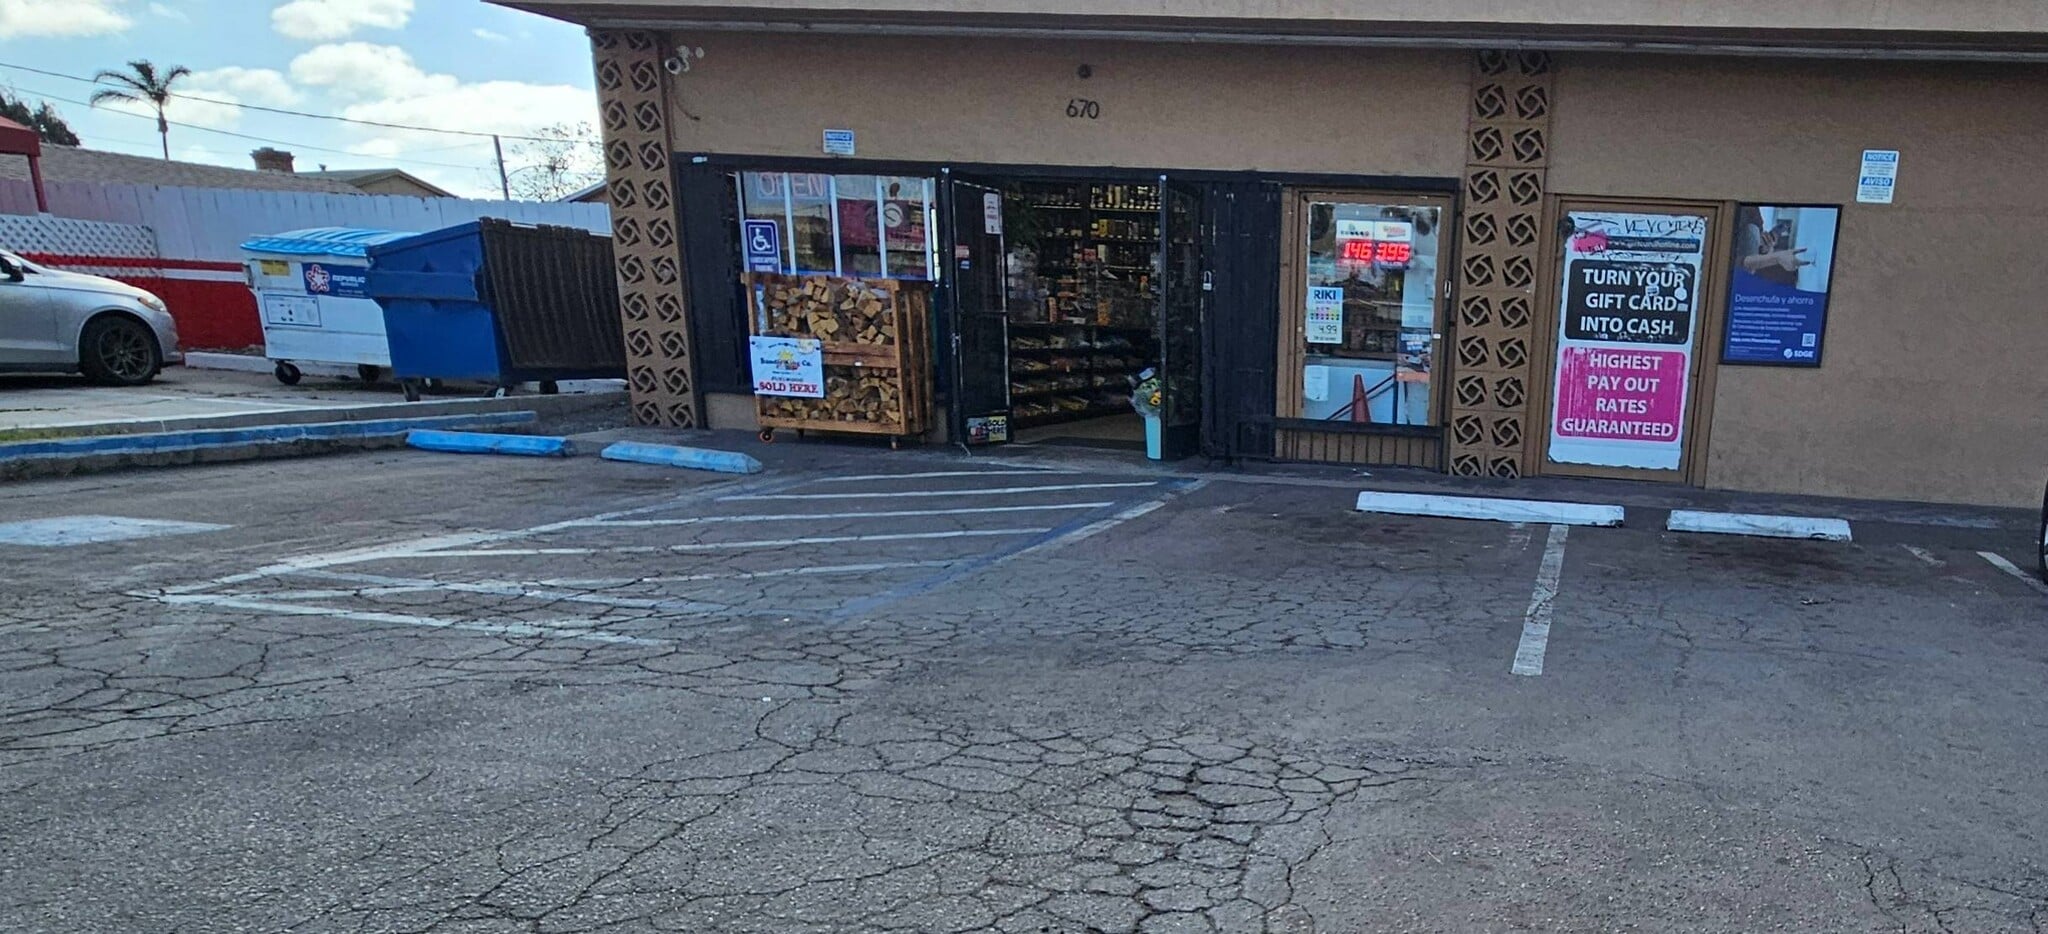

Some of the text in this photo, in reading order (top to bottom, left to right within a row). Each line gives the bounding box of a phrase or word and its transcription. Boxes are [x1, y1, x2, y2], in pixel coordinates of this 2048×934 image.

[1066, 99, 1099, 119] 670
[1866, 153, 1895, 161] NOTICE
[759, 172, 824, 197] OPEN
[1863, 177, 1890, 186] AVISO
[1343, 242, 1410, 261] 146 395
[332, 275, 366, 284] REPUBLIC
[1582, 268, 1686, 288] TURN YOUR
[1314, 289, 1337, 300] RIKI
[1585, 293, 1677, 311] GIFT CARD
[1735, 294, 1814, 306] Desenchufa y ahorra
[1580, 316, 1674, 335] INTO CASH
[1589, 353, 1662, 371] HIGHEST
[759, 382, 818, 393] SOLD HERE
[1587, 375, 1660, 393] PAY OUT
[1596, 398, 1647, 414] RATES
[1562, 418, 1673, 437] GUARANTEED
